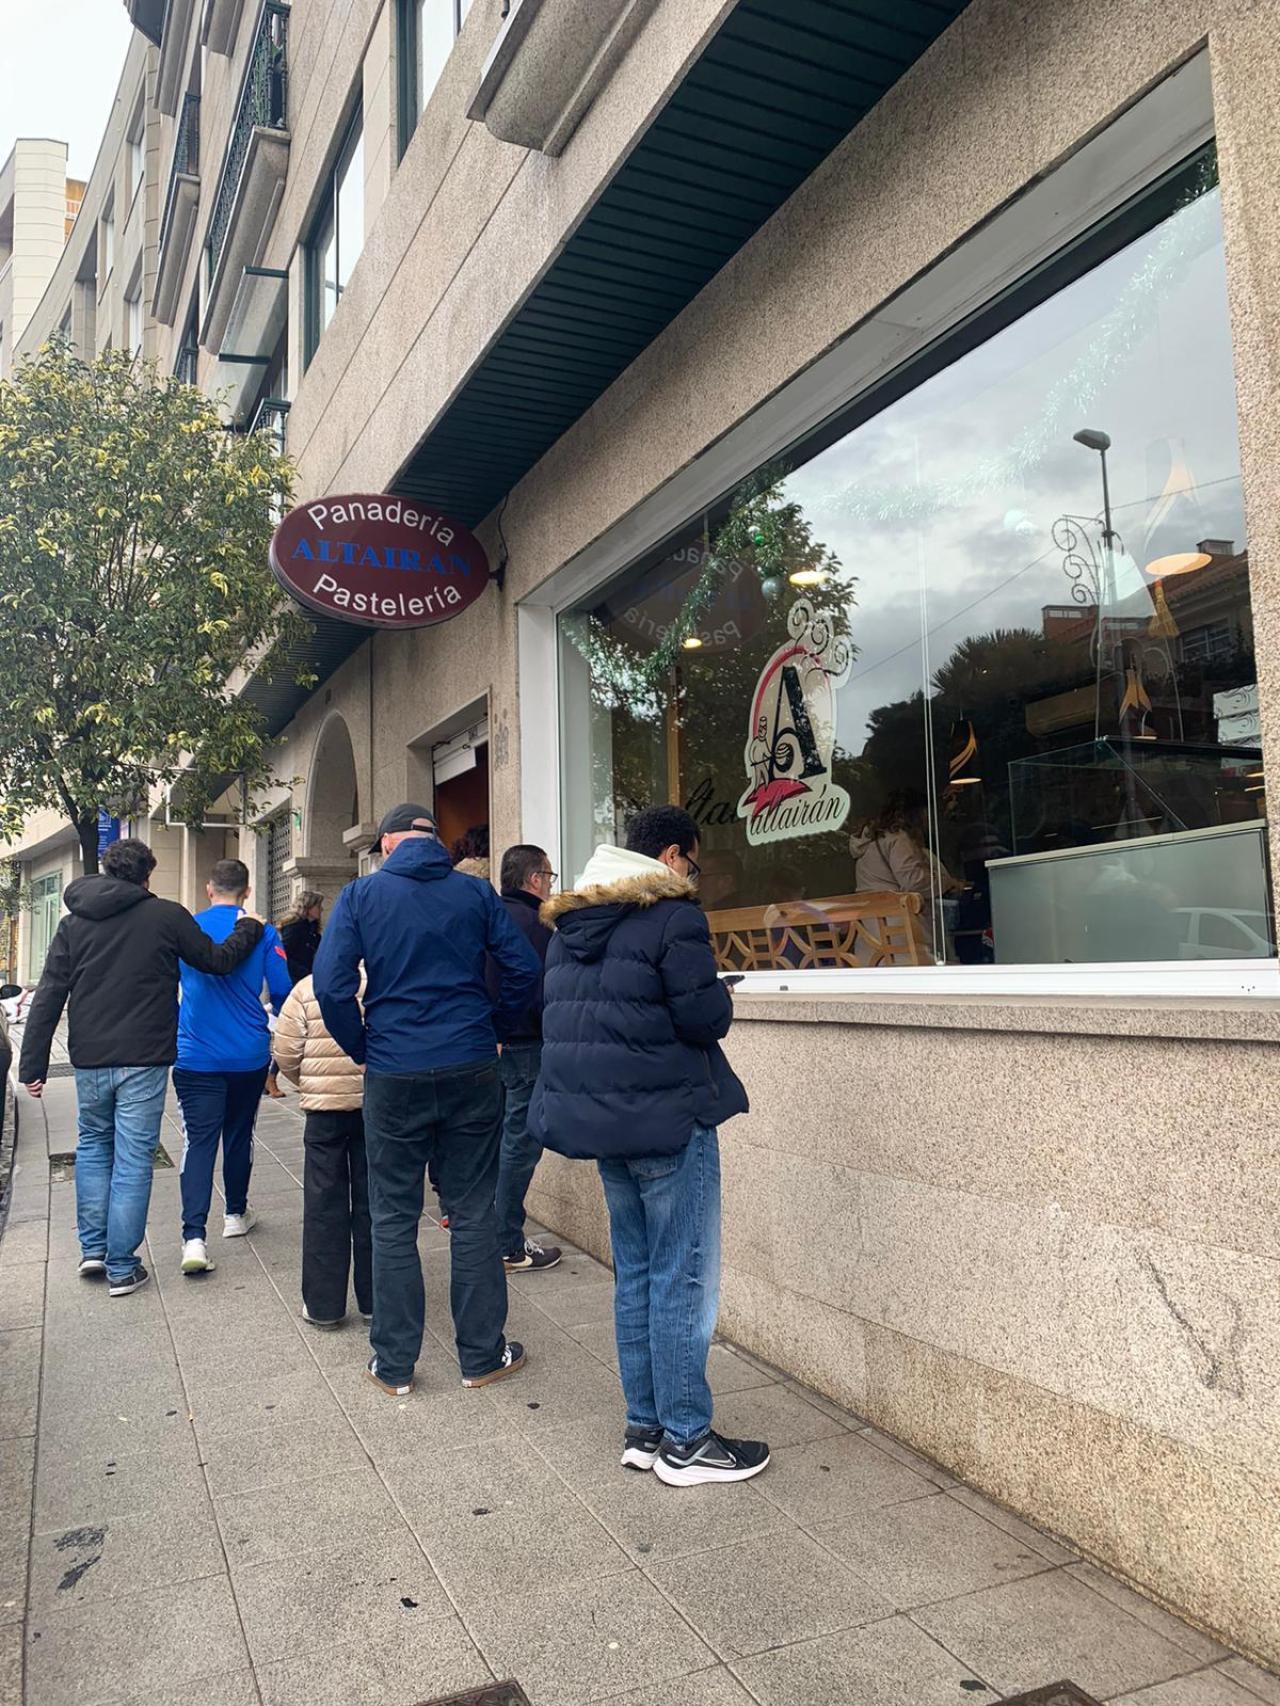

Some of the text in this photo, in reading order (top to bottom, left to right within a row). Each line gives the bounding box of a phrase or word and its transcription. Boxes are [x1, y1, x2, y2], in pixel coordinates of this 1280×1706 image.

[308, 501, 455, 546] Panadería
[292, 537, 471, 577] ALTAIRAN
[313, 574, 461, 616] Pastelería
[750, 785, 843, 836] altairán
